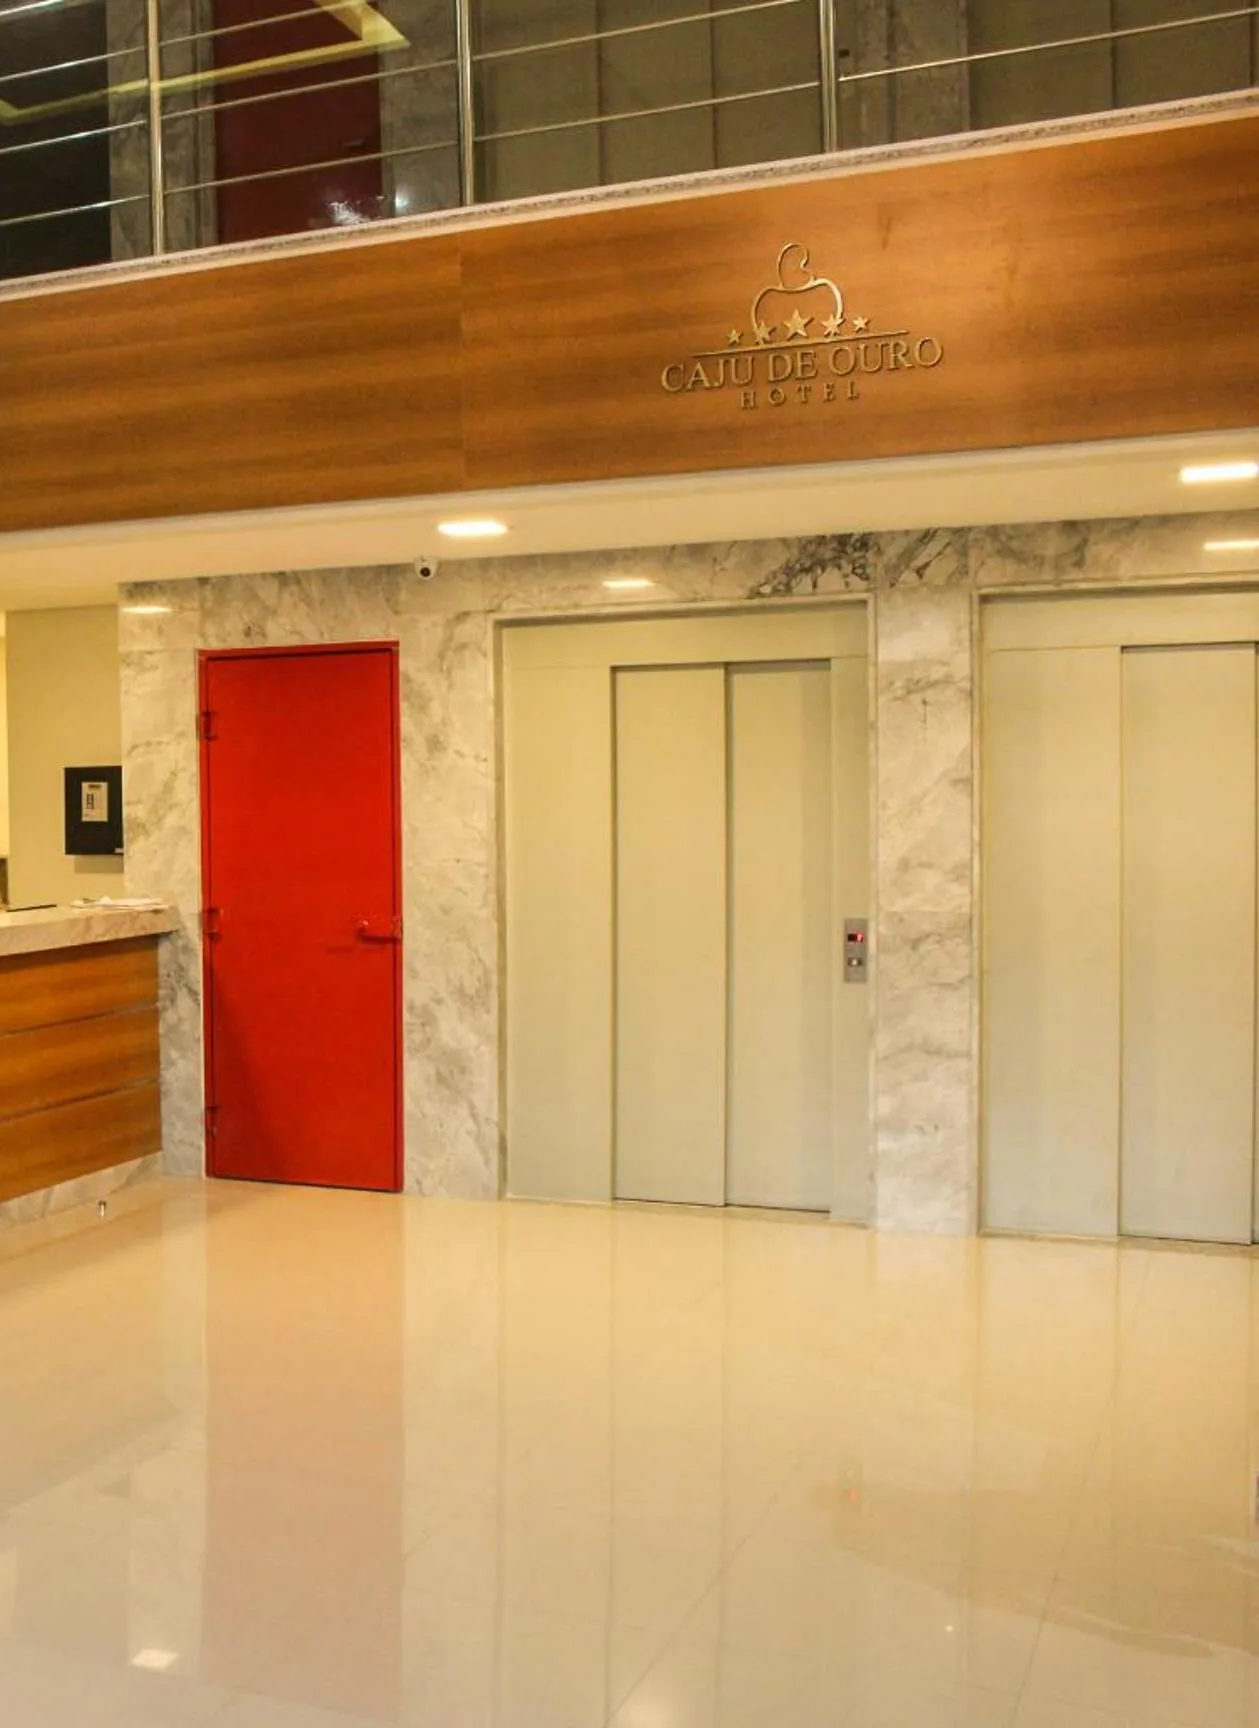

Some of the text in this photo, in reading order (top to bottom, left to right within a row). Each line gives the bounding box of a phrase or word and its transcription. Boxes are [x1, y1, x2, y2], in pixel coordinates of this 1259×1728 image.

[661, 337, 944, 392] CAJU DE OURO
[741, 381, 860, 409] HOTEL
